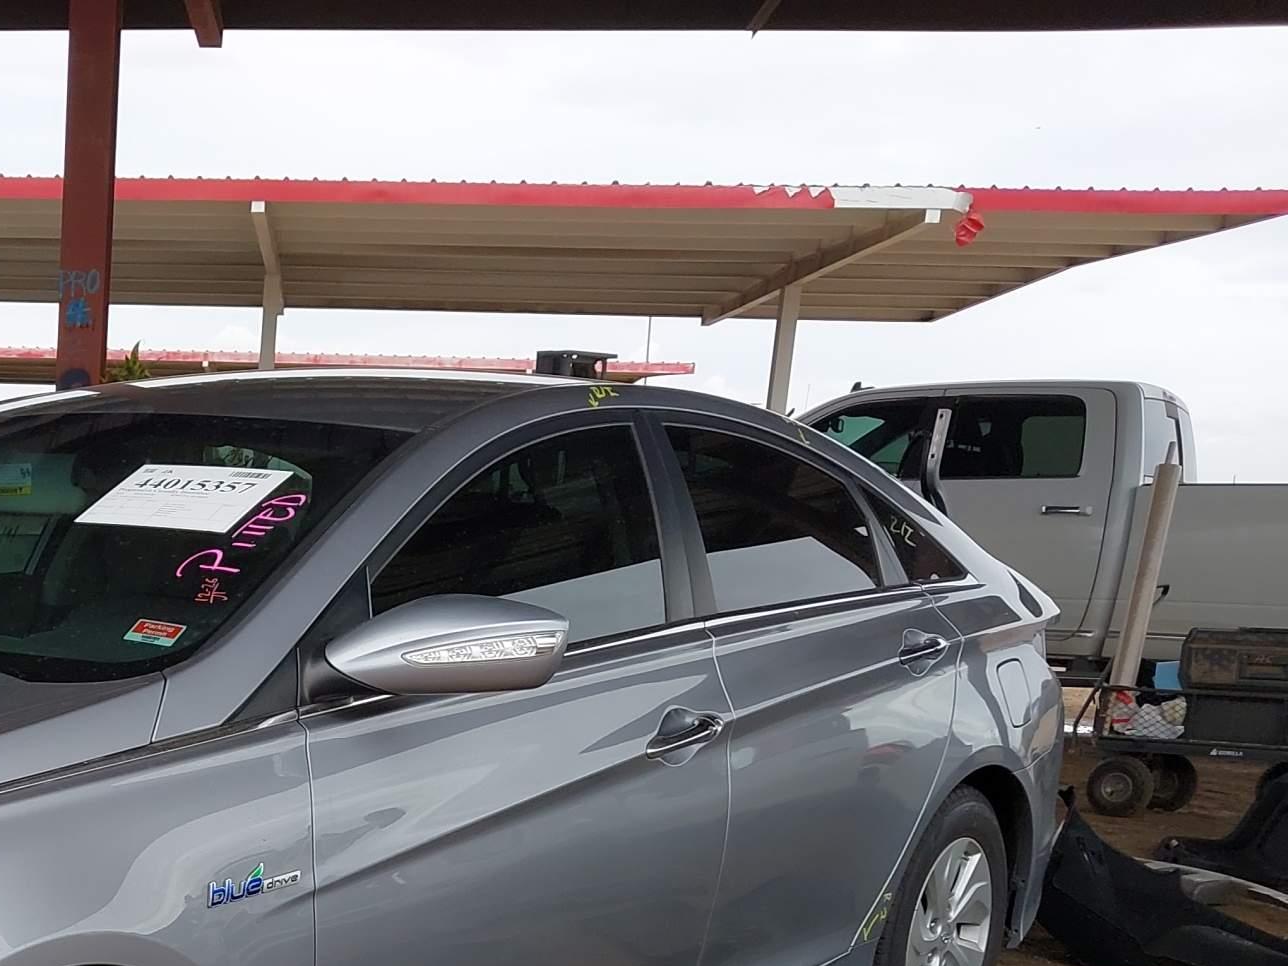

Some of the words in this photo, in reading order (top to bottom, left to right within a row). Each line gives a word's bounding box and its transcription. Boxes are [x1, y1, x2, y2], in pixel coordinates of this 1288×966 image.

[135, 478, 257, 494] 44015357
[208, 876, 263, 908] blue
[267, 874, 299, 889] drive
